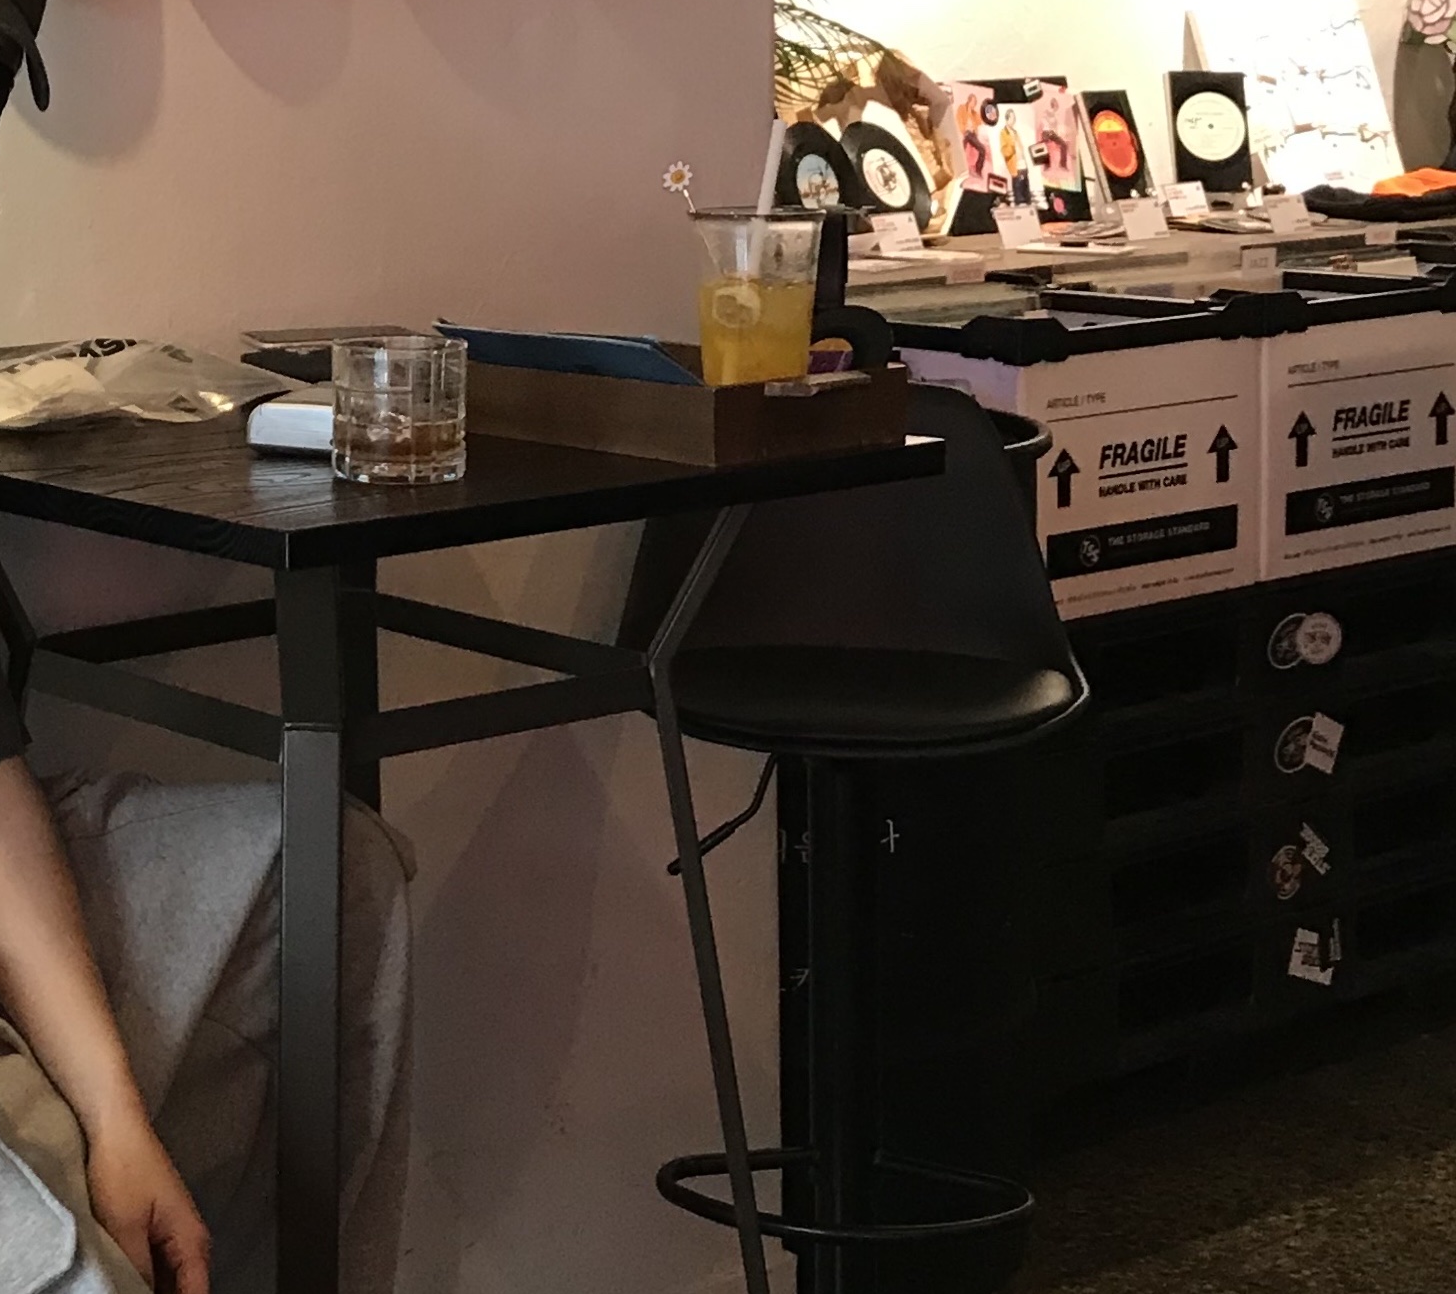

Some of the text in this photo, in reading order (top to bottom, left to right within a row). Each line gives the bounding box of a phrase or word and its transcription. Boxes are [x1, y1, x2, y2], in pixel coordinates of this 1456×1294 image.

[1332, 399, 1411, 432] FRAGILE
[1099, 434, 1187, 470] FRAGILE
[1367, 440, 1387, 453] WITH
[1098, 474, 1187, 498] HANDLE WITH CARE
[1167, 521, 1211, 537] STANDARD
